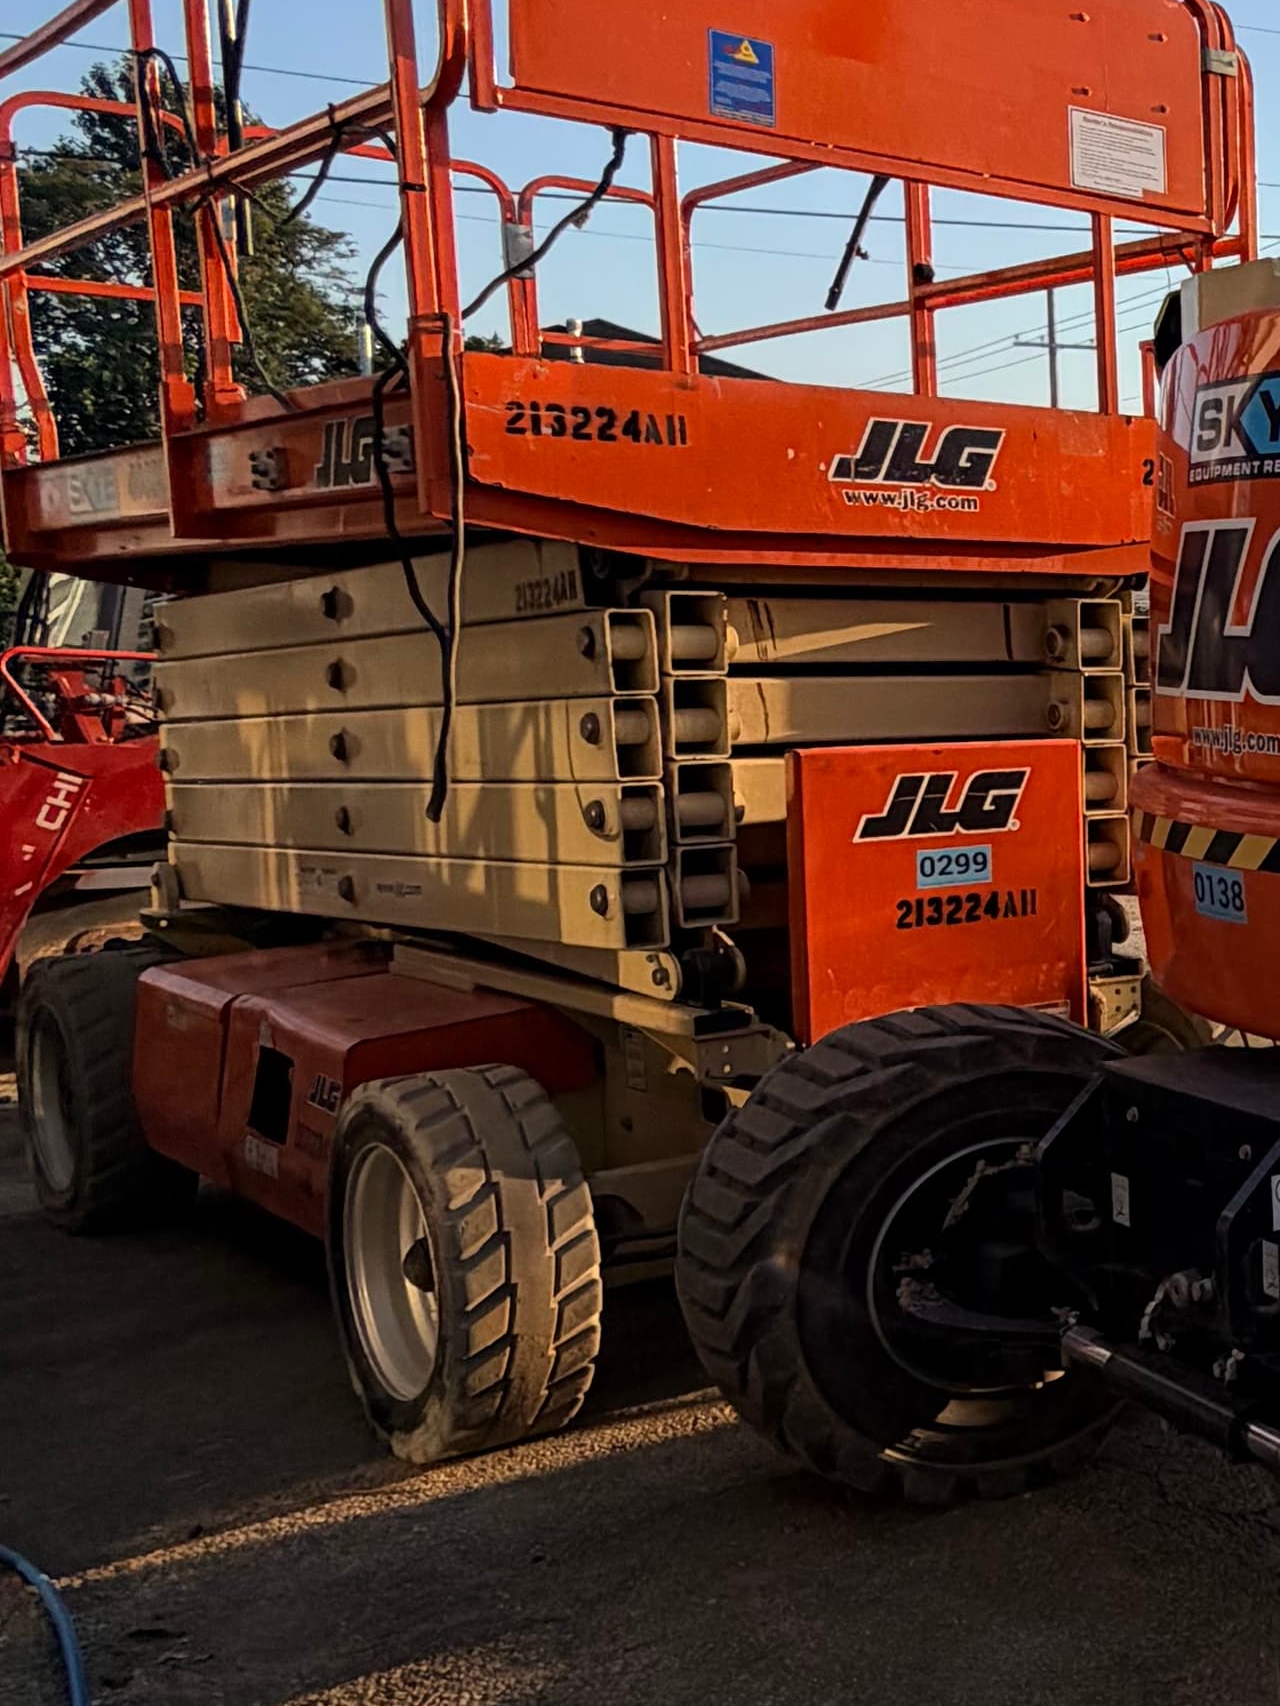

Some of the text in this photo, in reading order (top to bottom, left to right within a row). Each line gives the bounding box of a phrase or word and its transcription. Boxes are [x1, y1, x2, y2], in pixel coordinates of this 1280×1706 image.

[828, 417, 1007, 491] JLG
[1189, 460, 1261, 483] EQUIPMENT
[843, 488, 979, 513] www.jlg.com
[853, 767, 1031, 843] JLG
[919, 851, 988, 878] 0299
[1194, 871, 1245, 913] 0138
